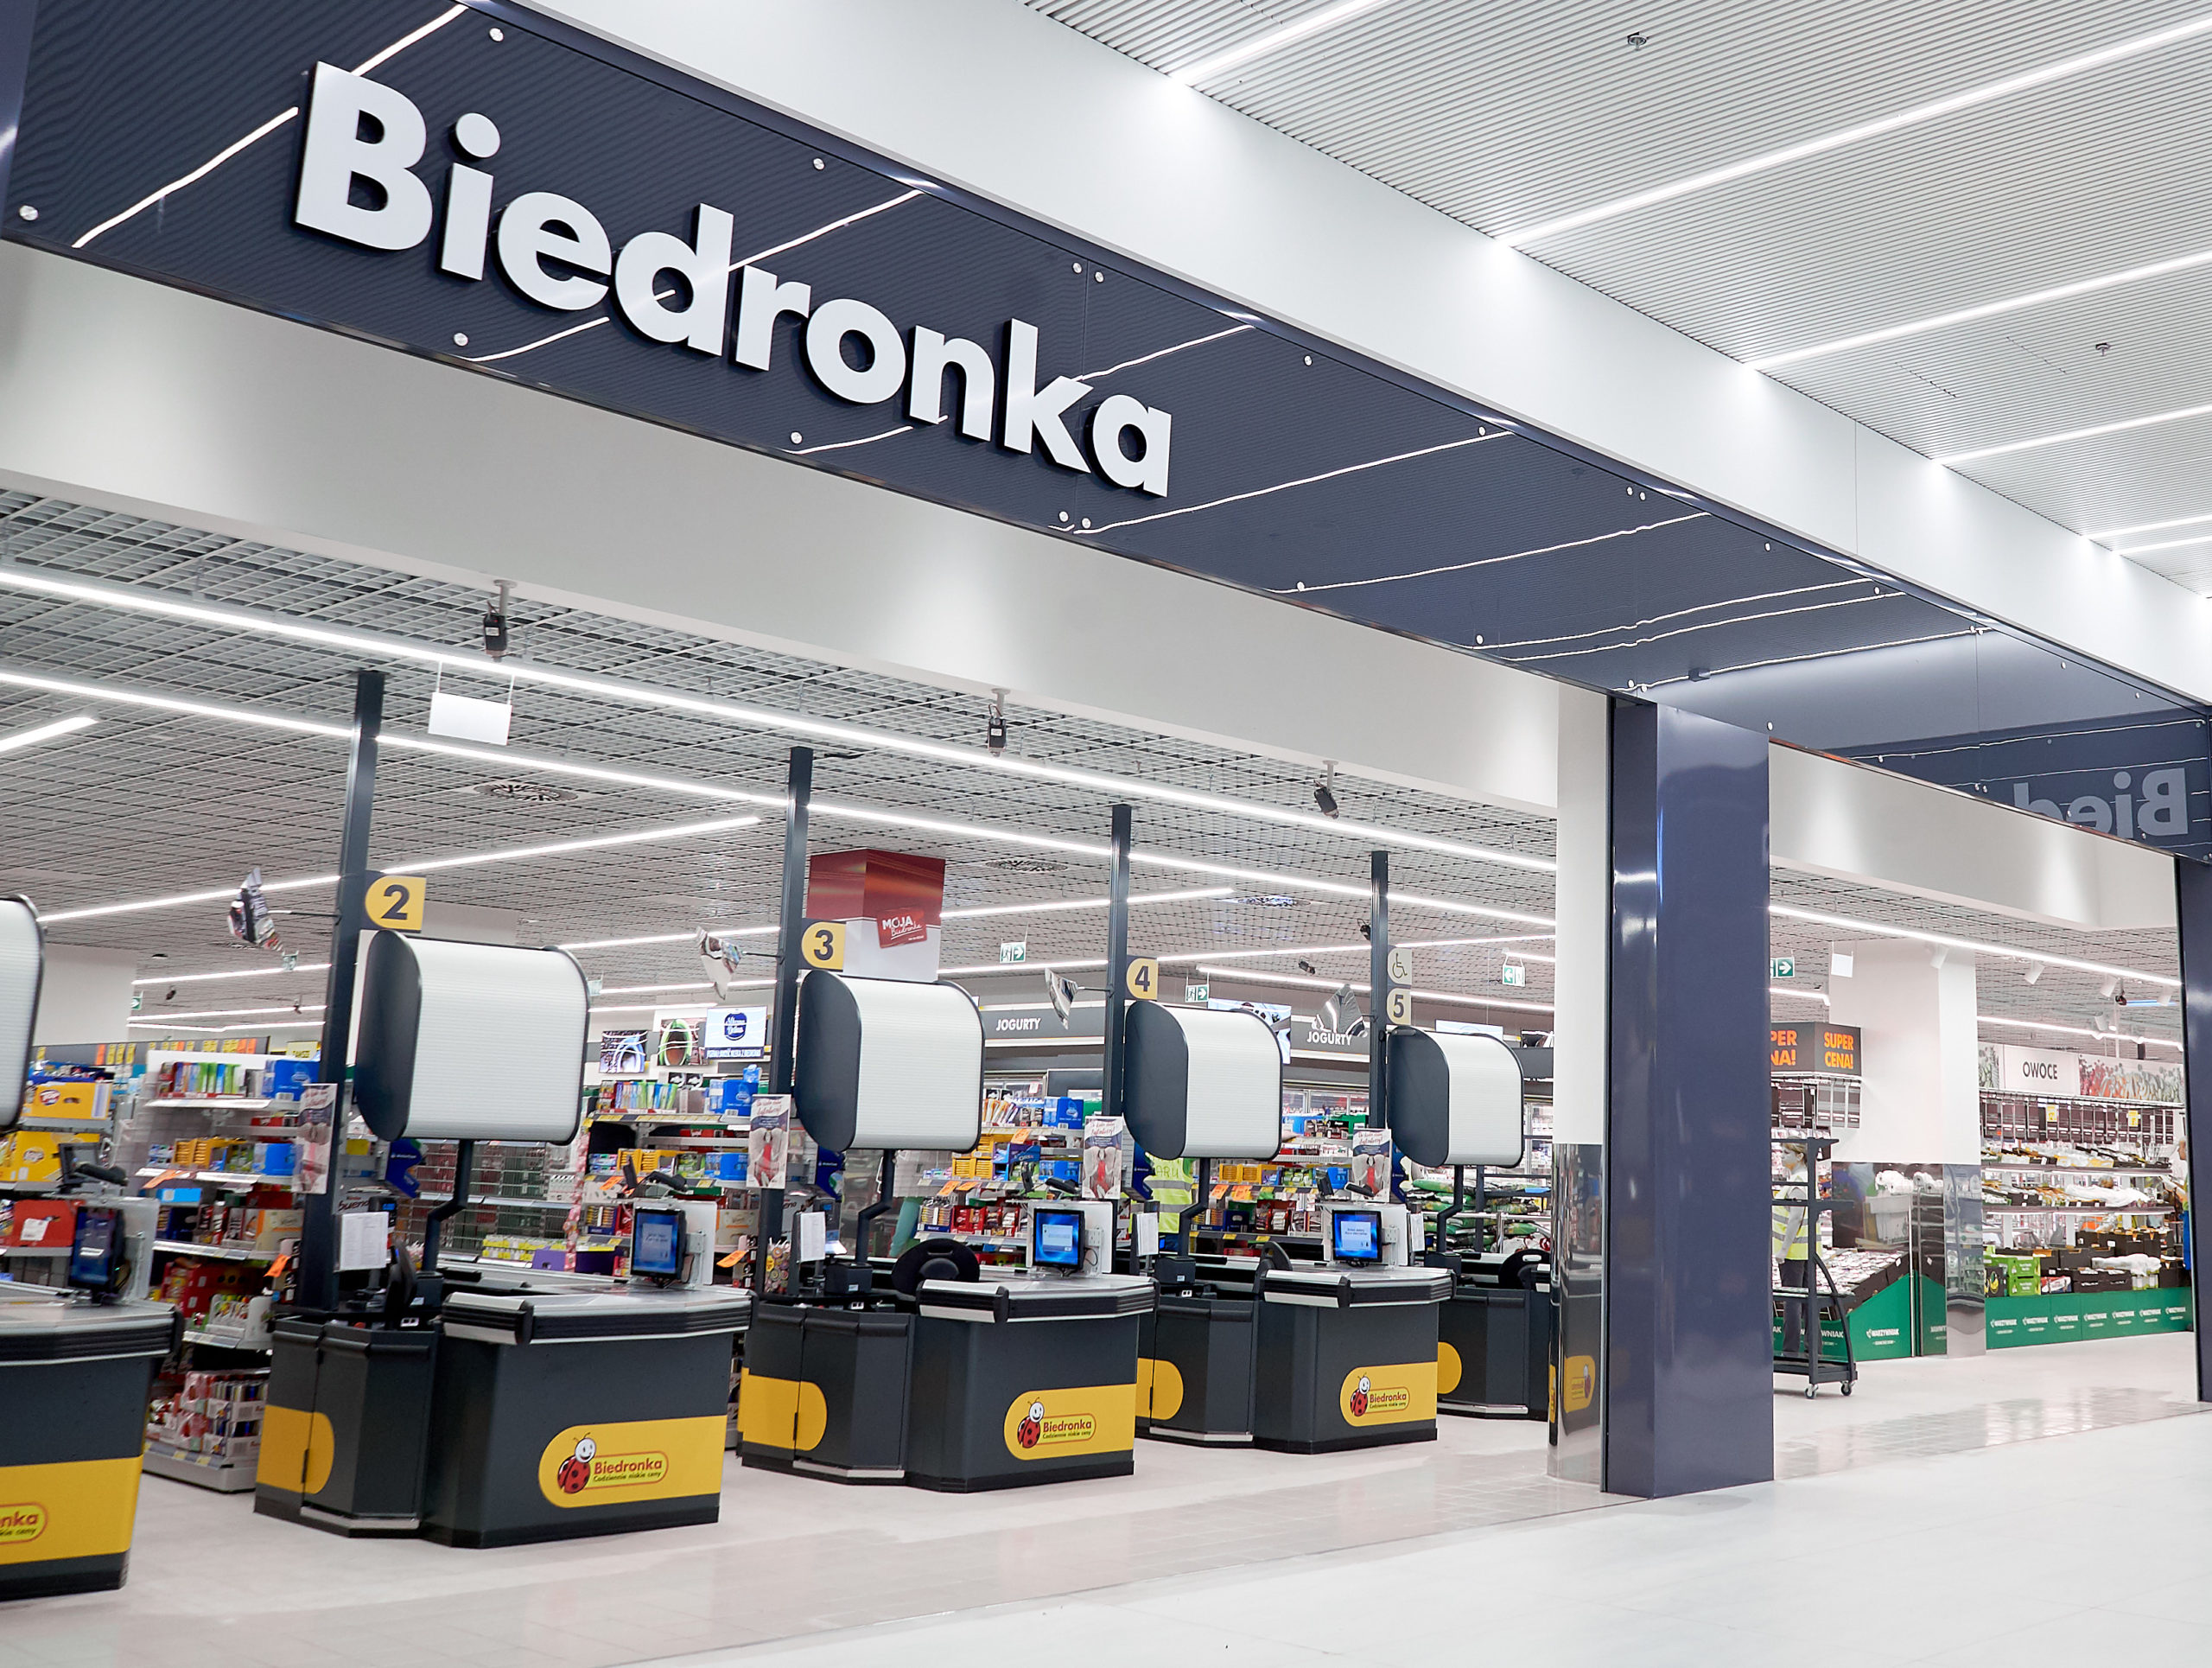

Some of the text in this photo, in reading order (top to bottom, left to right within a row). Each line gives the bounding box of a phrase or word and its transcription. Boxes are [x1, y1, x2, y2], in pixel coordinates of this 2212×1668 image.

[295, 60, 1173, 500] Biedronka
[381, 884, 410, 920] 2
[881, 915, 913, 930] MOJA
[813, 929, 835, 961] 3
[1134, 965, 1151, 992] 4
[1393, 994, 1405, 1018] 5
[995, 1017, 1042, 1031] JOGURTY
[1306, 1030, 1352, 1046] JOGURTY
[1823, 1031, 1854, 1051] SUPER
[1824, 1050, 1854, 1070] CENA!
[2022, 1060, 2058, 1080] OWOCE
[1370, 1392, 1407, 1403] Biedronka
[1043, 1419, 1091, 1432] Biedronka
[594, 1458, 662, 1474] Biedronka
